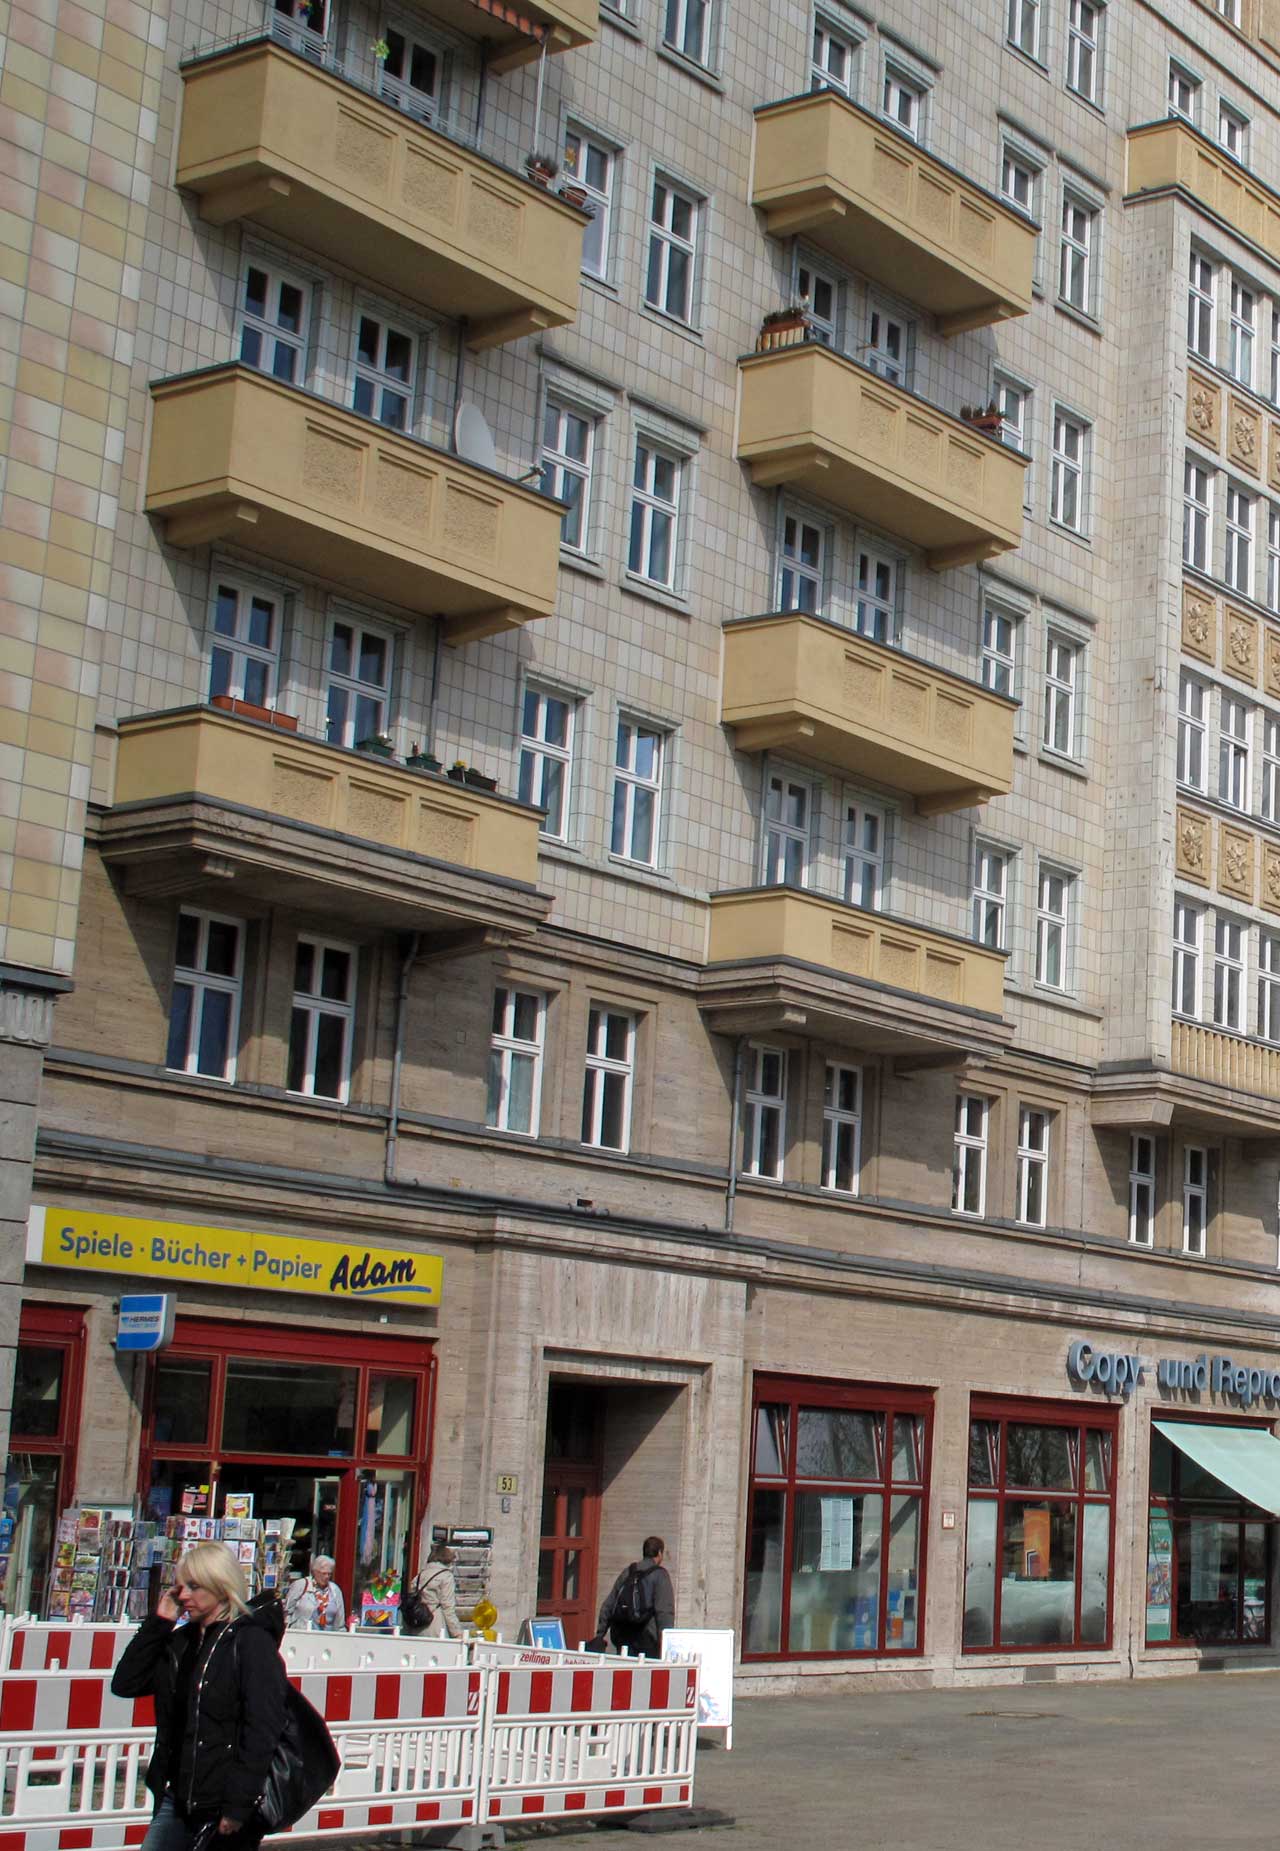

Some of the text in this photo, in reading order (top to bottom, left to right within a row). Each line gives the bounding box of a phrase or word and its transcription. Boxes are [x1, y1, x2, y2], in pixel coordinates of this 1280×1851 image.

[60, 1226, 133, 1259] Spiele
[151, 1237, 231, 1269] Bücher
[253, 1250, 322, 1280] Papier
[330, 1253, 417, 1292] Adam
[129, 1315, 160, 1323] HERMES
[1157, 1355, 1209, 1392] und
[502, 1477, 513, 1491] 53
